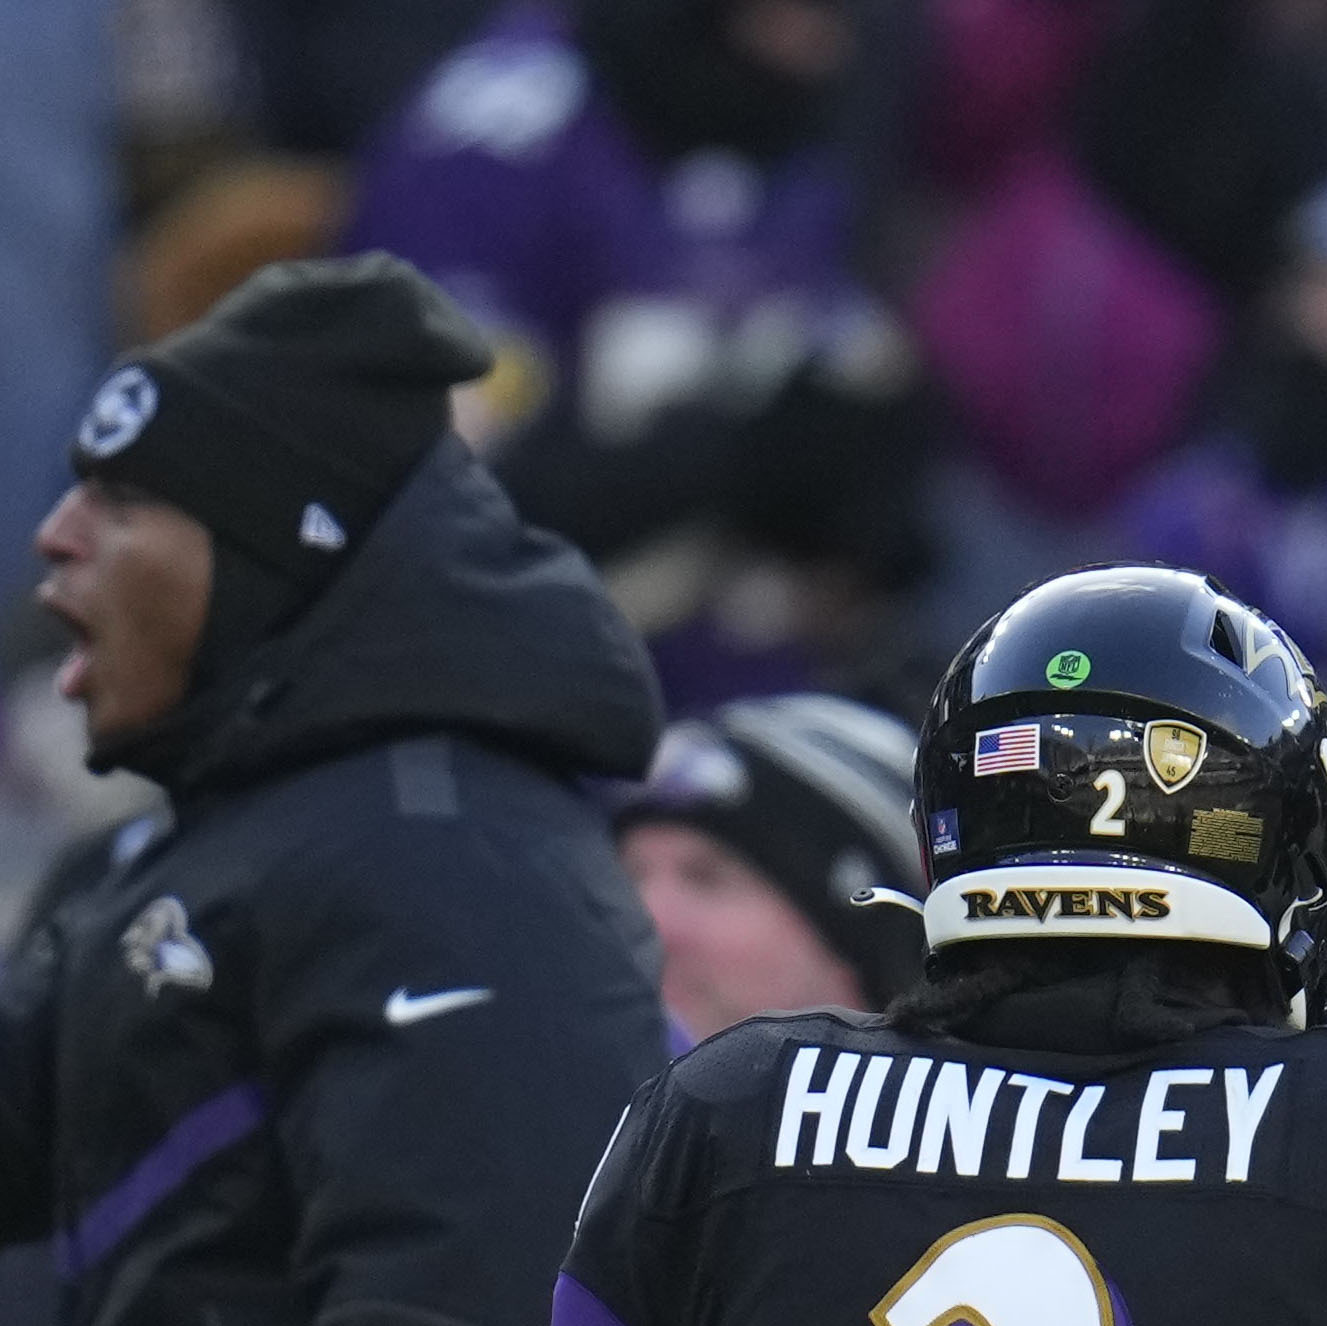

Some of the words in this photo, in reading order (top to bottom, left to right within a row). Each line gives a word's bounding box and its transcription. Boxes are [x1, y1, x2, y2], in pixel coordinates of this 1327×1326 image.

[1089, 769, 1128, 837] 2
[960, 886, 1172, 924] RAVENS
[775, 1046, 1285, 1184] HUNTLEY
